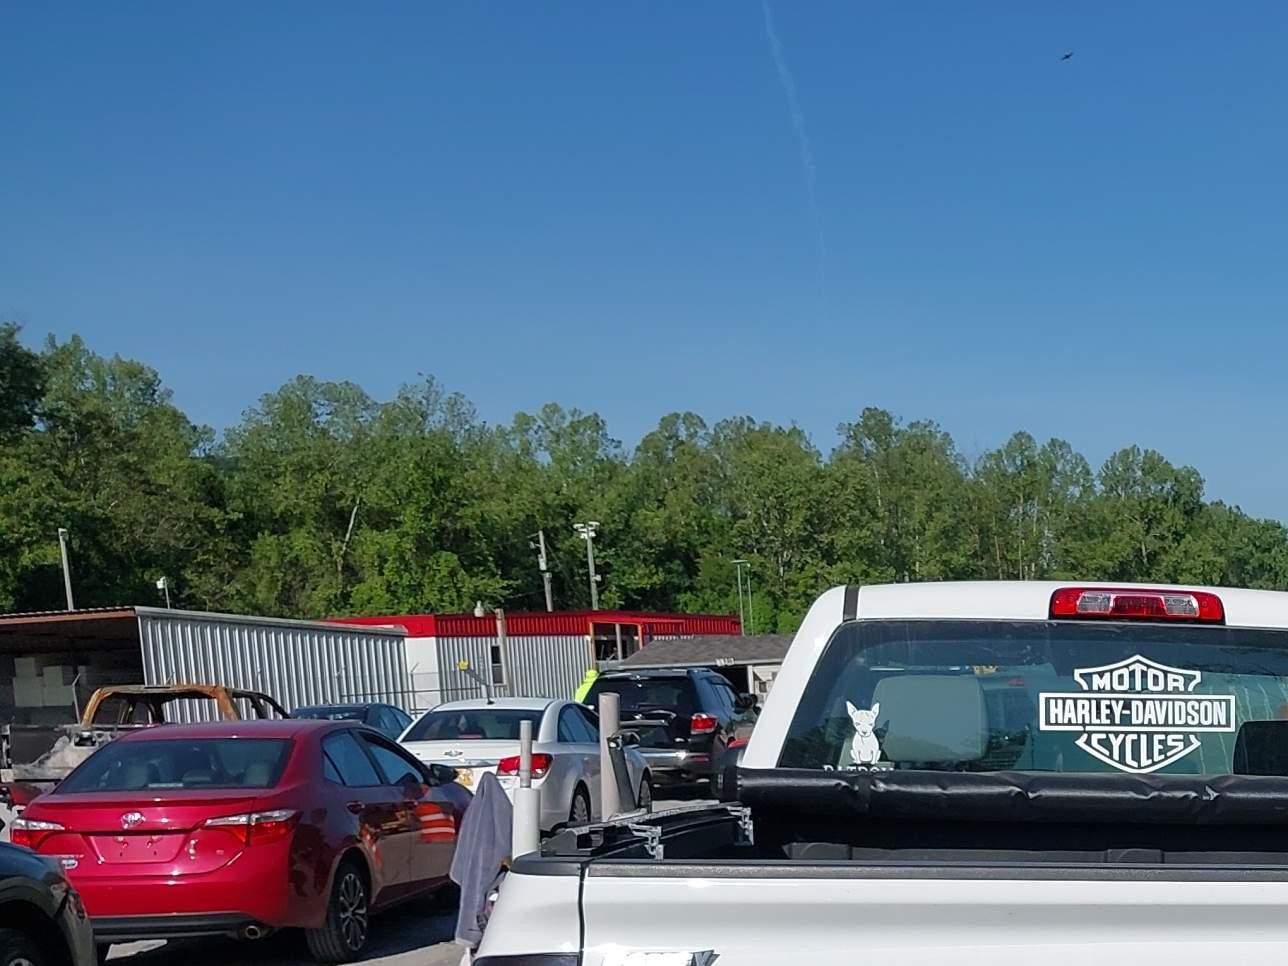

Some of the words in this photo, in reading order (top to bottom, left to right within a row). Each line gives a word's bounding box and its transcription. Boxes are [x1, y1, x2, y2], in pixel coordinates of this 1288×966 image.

[1091, 661, 1185, 692] MOTOR
[1049, 697, 1227, 726] HARLEY-DAVIDSON
[1090, 733, 1185, 768] CYCLES
